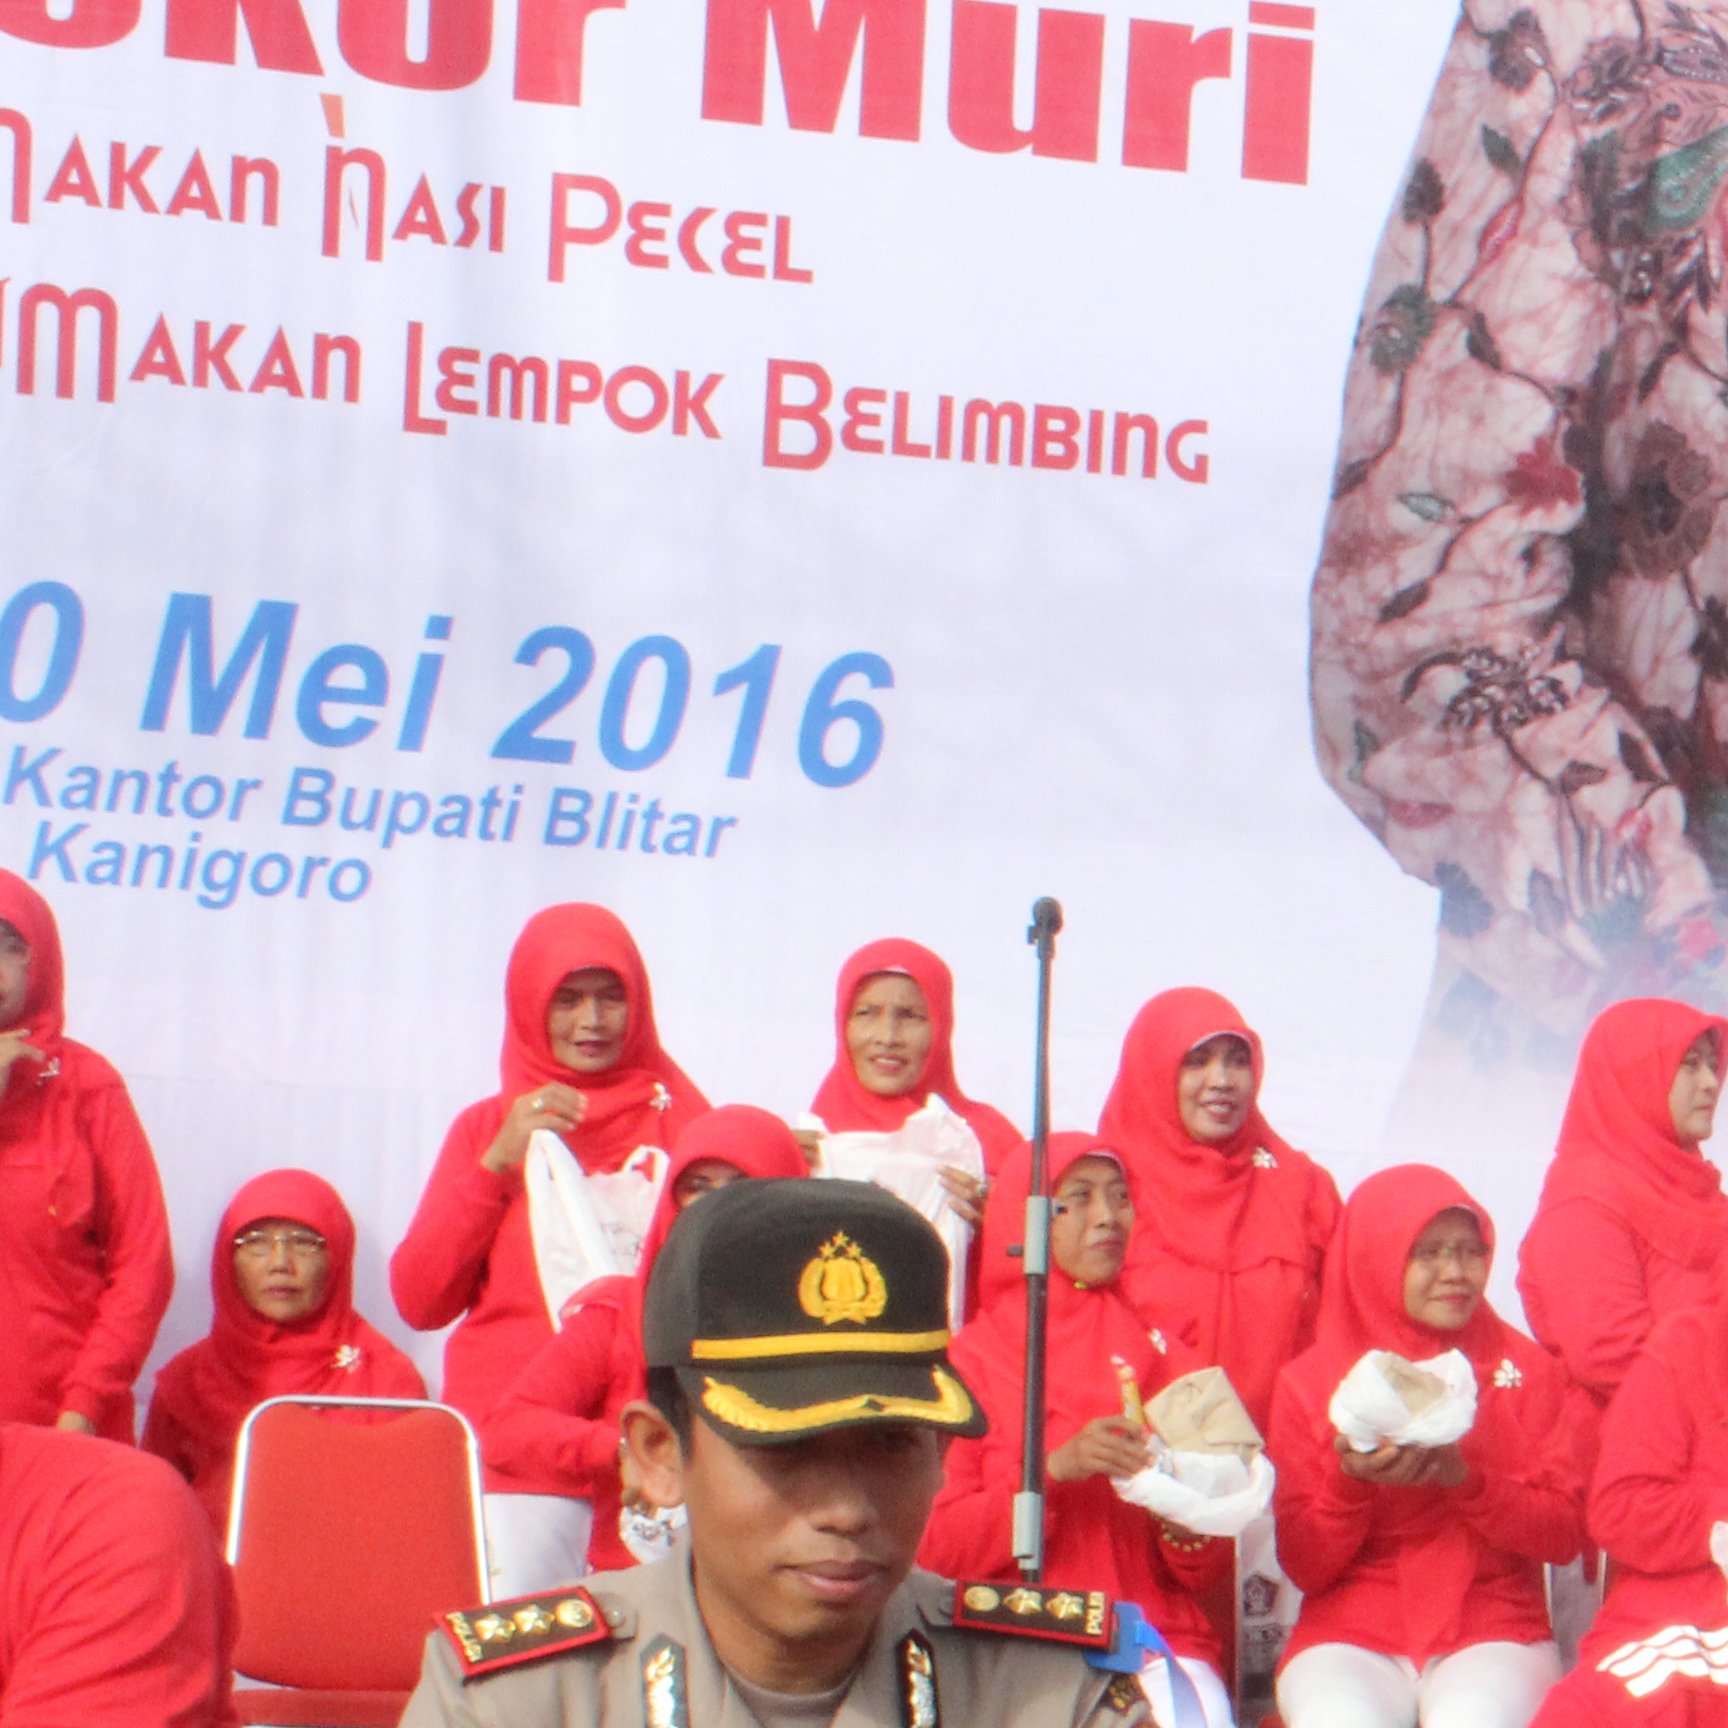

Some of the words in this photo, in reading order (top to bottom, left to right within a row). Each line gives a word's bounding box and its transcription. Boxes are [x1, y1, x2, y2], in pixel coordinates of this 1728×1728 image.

[700, 0, 1316, 186] Muri
[139, 592, 455, 753] Mei
[490, 625, 896, 789] 2016
[5, 745, 261, 822] Kantor
[281, 767, 525, 850] Bupati
[543, 786, 740, 859] Blitar
[27, 820, 373, 910] Kanigoro
